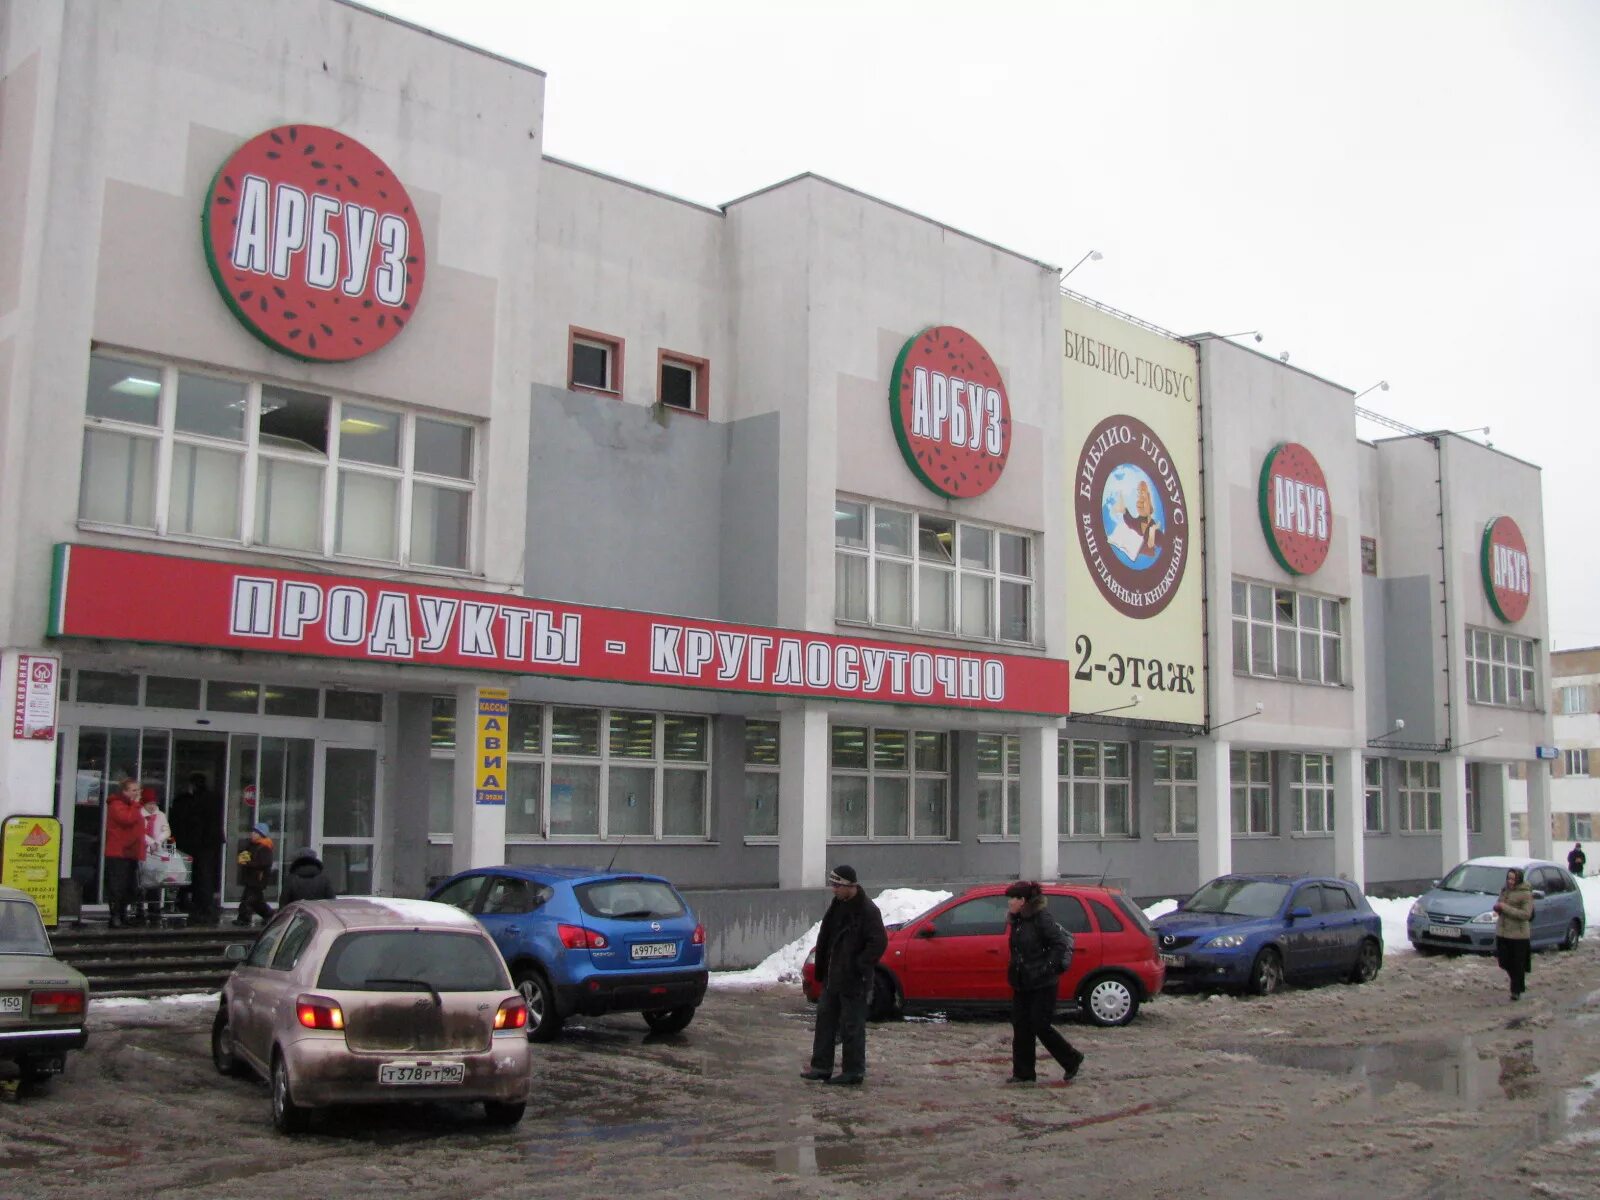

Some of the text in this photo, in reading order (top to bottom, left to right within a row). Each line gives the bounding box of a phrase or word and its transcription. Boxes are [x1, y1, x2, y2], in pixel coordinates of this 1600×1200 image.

[232, 174, 410, 308] АРБУЗ
[1063, 328, 1193, 403] БИБЛИО-ГЛОБУС
[911, 365, 1003, 457] АРБУЗ
[1140, 433, 1184, 525] ГЛОБУС
[1274, 474, 1327, 541] АРБУЗ
[1082, 513, 1184, 606] ВАШ ГЛАВНЫЙ КНИЖНЫЙ
[1493, 543, 1529, 596] АРБУЗ
[229, 575, 582, 667] ПРОДУКТЫ
[649, 623, 1005, 702] КРУГЛОСУТОЧНО
[1074, 634, 1196, 695] 2-этаж
[15, 658, 28, 735] СТРАХОВАНИЕ
[480, 702, 508, 713] КАССЫ
[482, 718, 502, 788] АВИА
[2, 997, 20, 1008] 150
